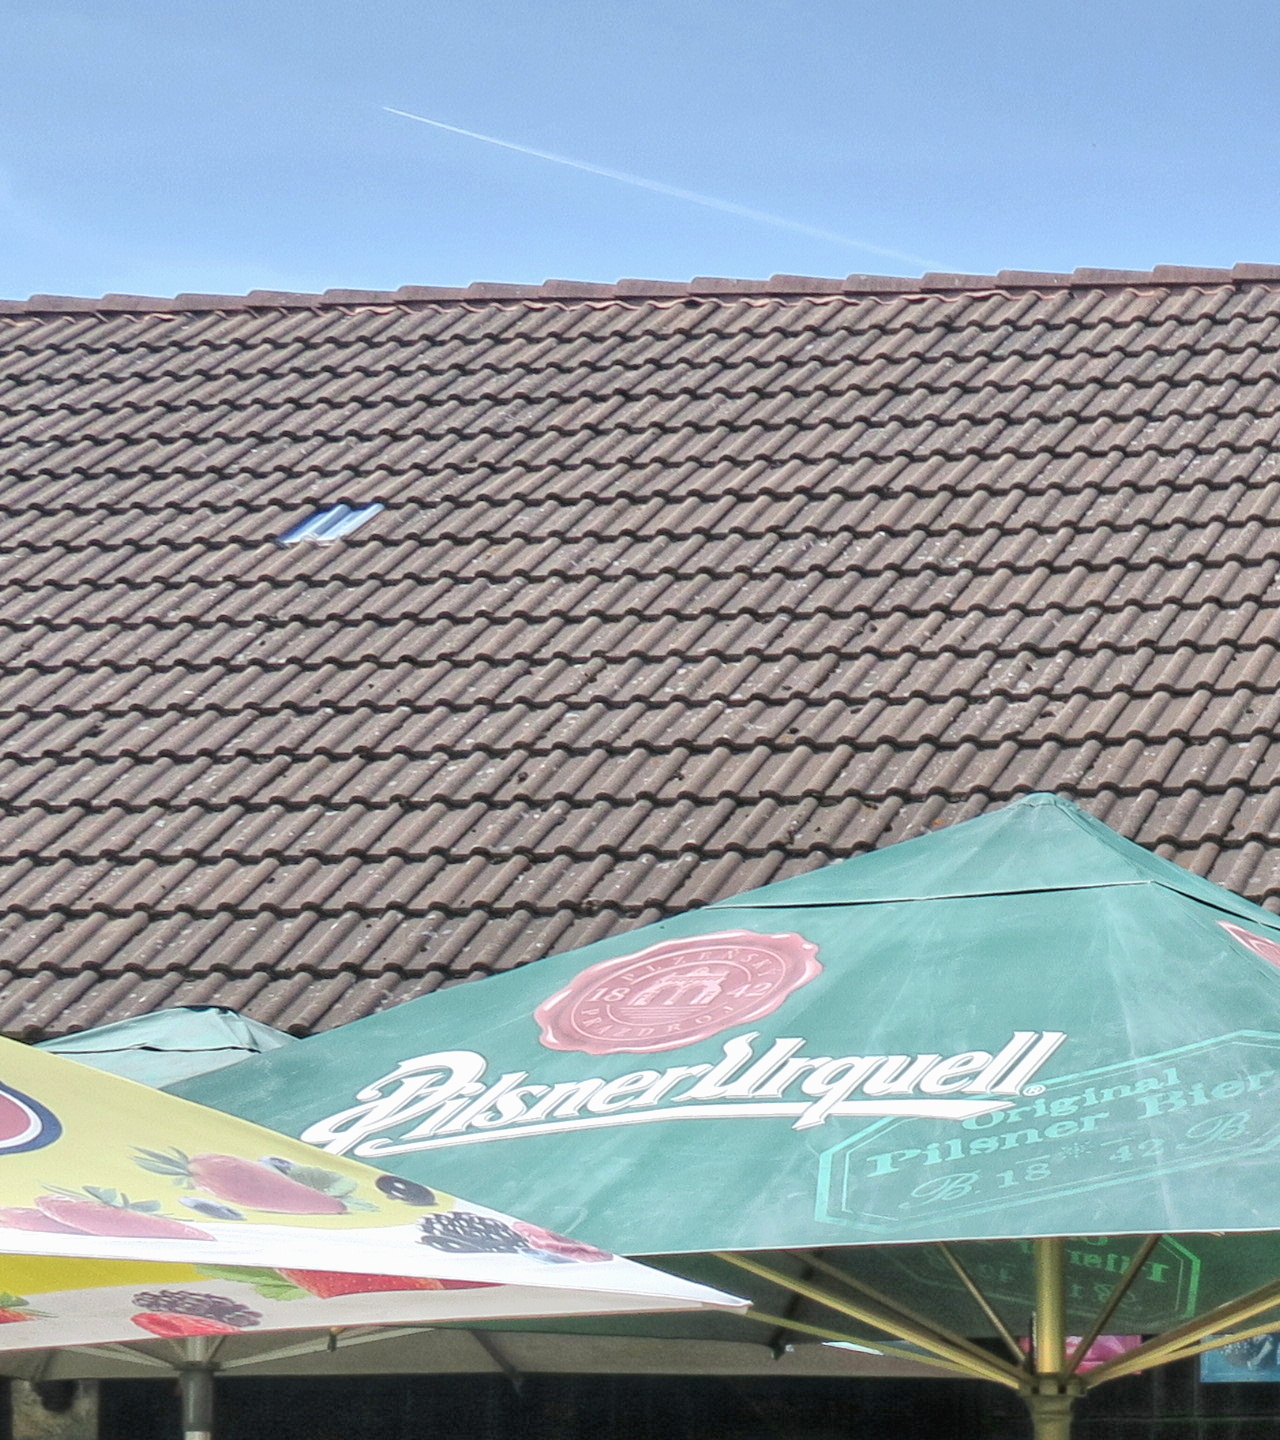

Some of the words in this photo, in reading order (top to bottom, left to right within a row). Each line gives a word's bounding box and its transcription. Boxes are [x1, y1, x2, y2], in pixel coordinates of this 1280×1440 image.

[591, 986, 631, 1002] 18
[726, 982, 773, 998] 42
[867, 1112, 1110, 1178] Pilsner
[1137, 1069, 1276, 1121] Bier
[962, 1068, 1181, 1131] Original
[997, 1162, 1052, 1189] 18
[1108, 1137, 1166, 1163] 42
